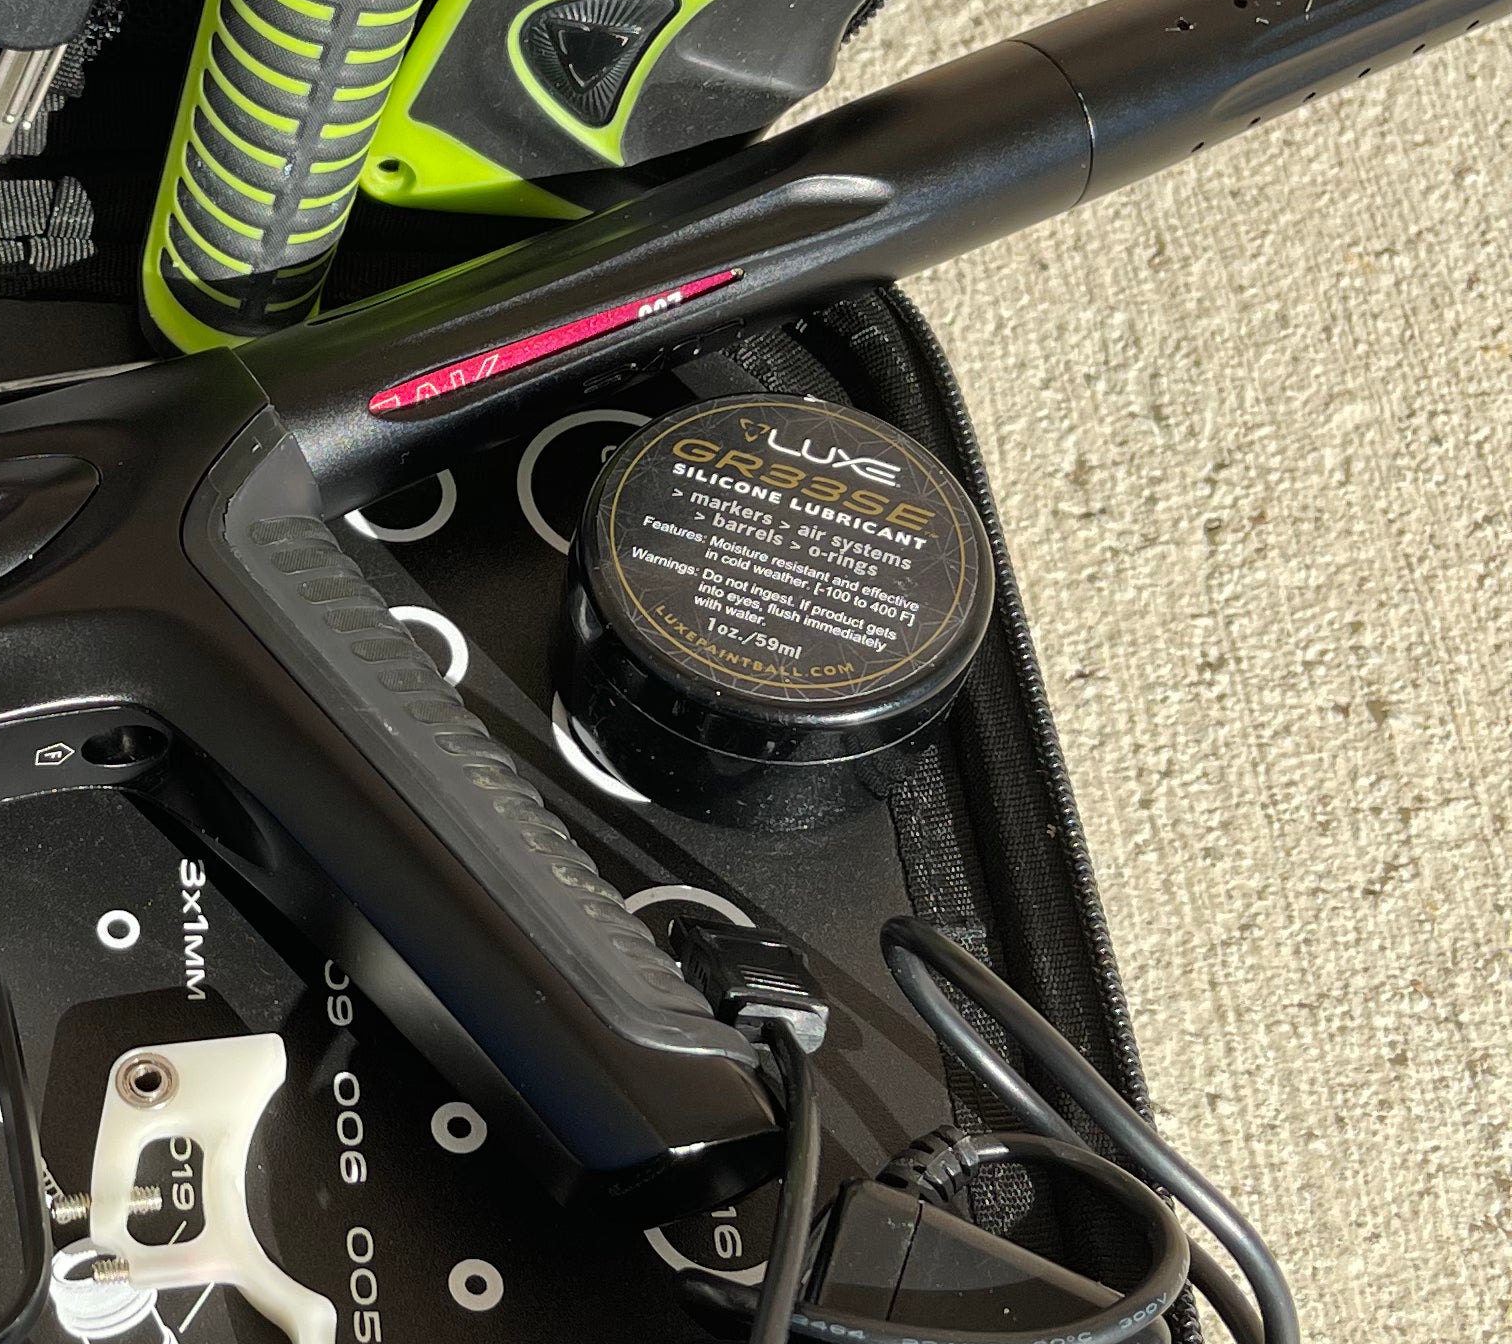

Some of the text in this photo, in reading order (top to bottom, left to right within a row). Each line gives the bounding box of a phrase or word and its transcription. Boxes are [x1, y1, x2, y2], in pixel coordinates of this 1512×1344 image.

[673, 439, 936, 532] GR33SE
[768, 428, 901, 487] LUXE
[672, 462, 927, 550] SILICONE LUBRICANT
[690, 491, 773, 525] markers
[797, 524, 826, 541] air
[830, 535, 912, 570] systems
[712, 512, 783, 546] barrels
[808, 545, 878, 577] o-rings
[631, 546, 897, 641] Warnings: Do not ingest. If product gets
[643, 515, 920, 612] Features: Moisture resistant and effective
[705, 547, 718, 561] in
[721, 554, 751, 571] cold
[753, 564, 810, 590] weather.
[854, 595, 868, 608] to
[870, 601, 897, 618] 400
[655, 605, 855, 677] LUXEPAINTBALL.COM
[694, 595, 767, 627] with water.
[698, 581, 725, 598] into
[767, 603, 801, 623] flush
[803, 615, 887, 653] immediately
[333, 1071, 368, 1184] 006
[346, 1226, 383, 1344] 005
